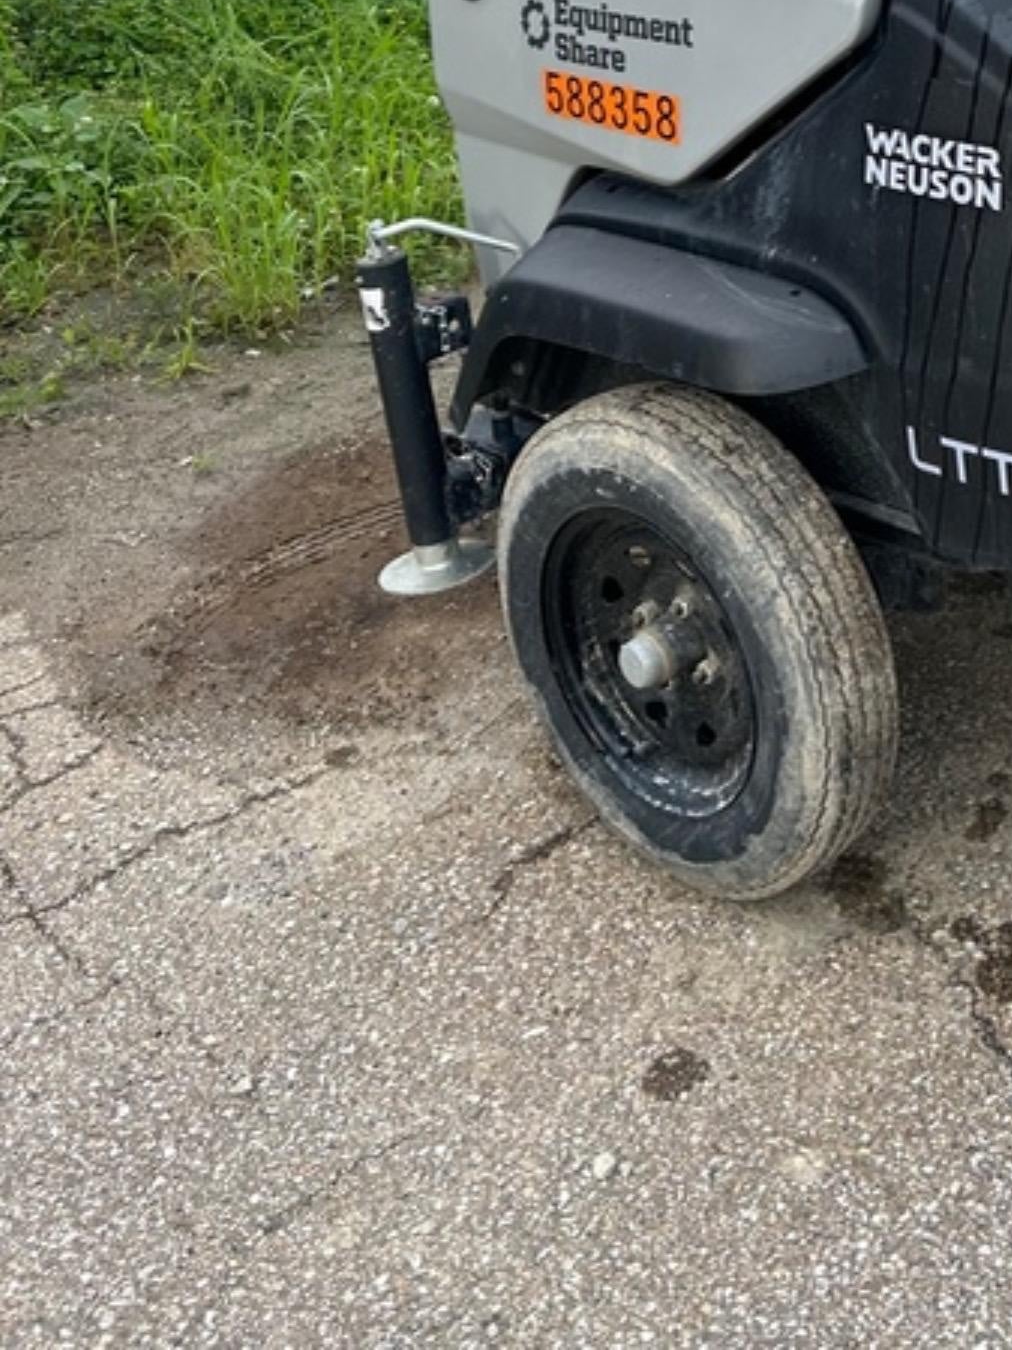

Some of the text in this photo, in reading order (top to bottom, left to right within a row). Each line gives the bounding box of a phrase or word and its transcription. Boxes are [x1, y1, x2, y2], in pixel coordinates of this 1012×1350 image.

[555, 32, 626, 72] Share
[545, 71, 677, 141] 588358
[864, 122, 1002, 178] WACKER
[864, 154, 1002, 212] NEUSON
